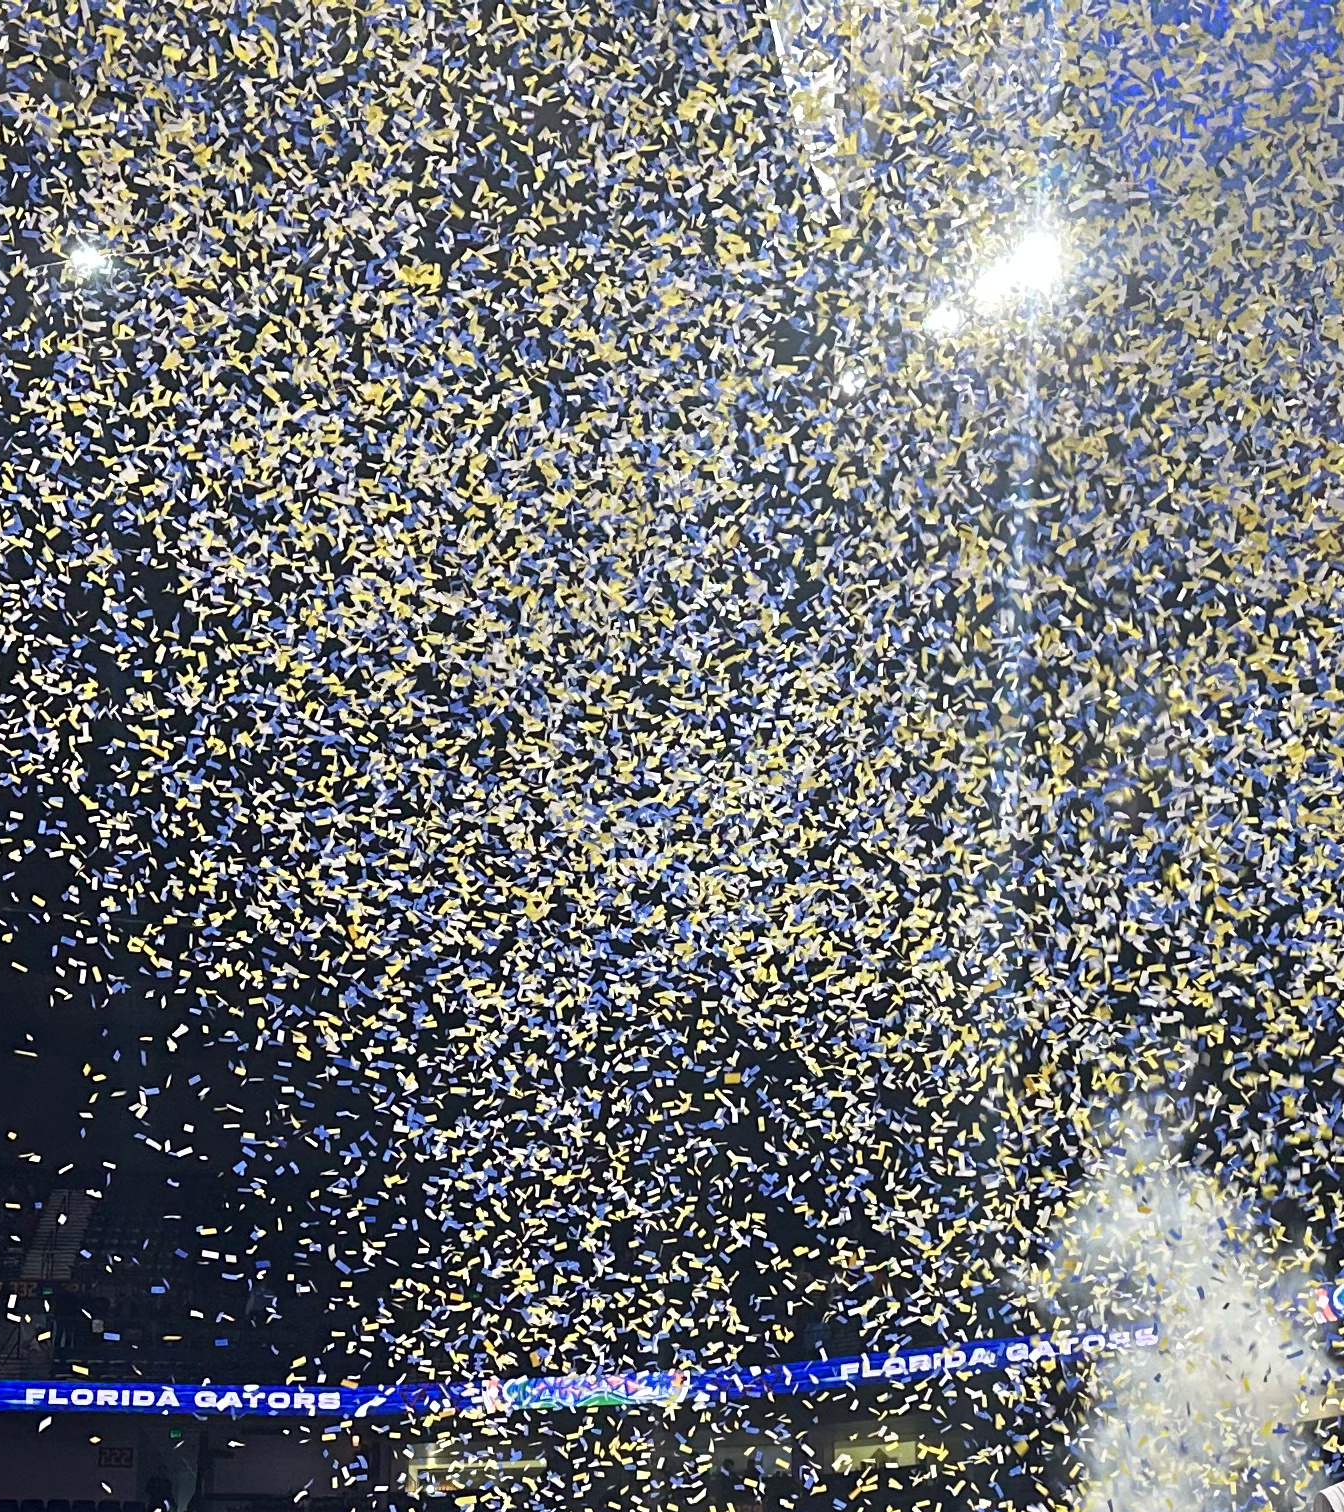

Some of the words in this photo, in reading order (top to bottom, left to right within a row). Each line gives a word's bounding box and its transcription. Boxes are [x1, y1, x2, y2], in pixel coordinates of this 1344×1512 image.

[839, 1346, 996, 1381] FLORIDA
[25, 1387, 180, 1408] FLORIDA
[194, 1391, 342, 1411] GATORS
